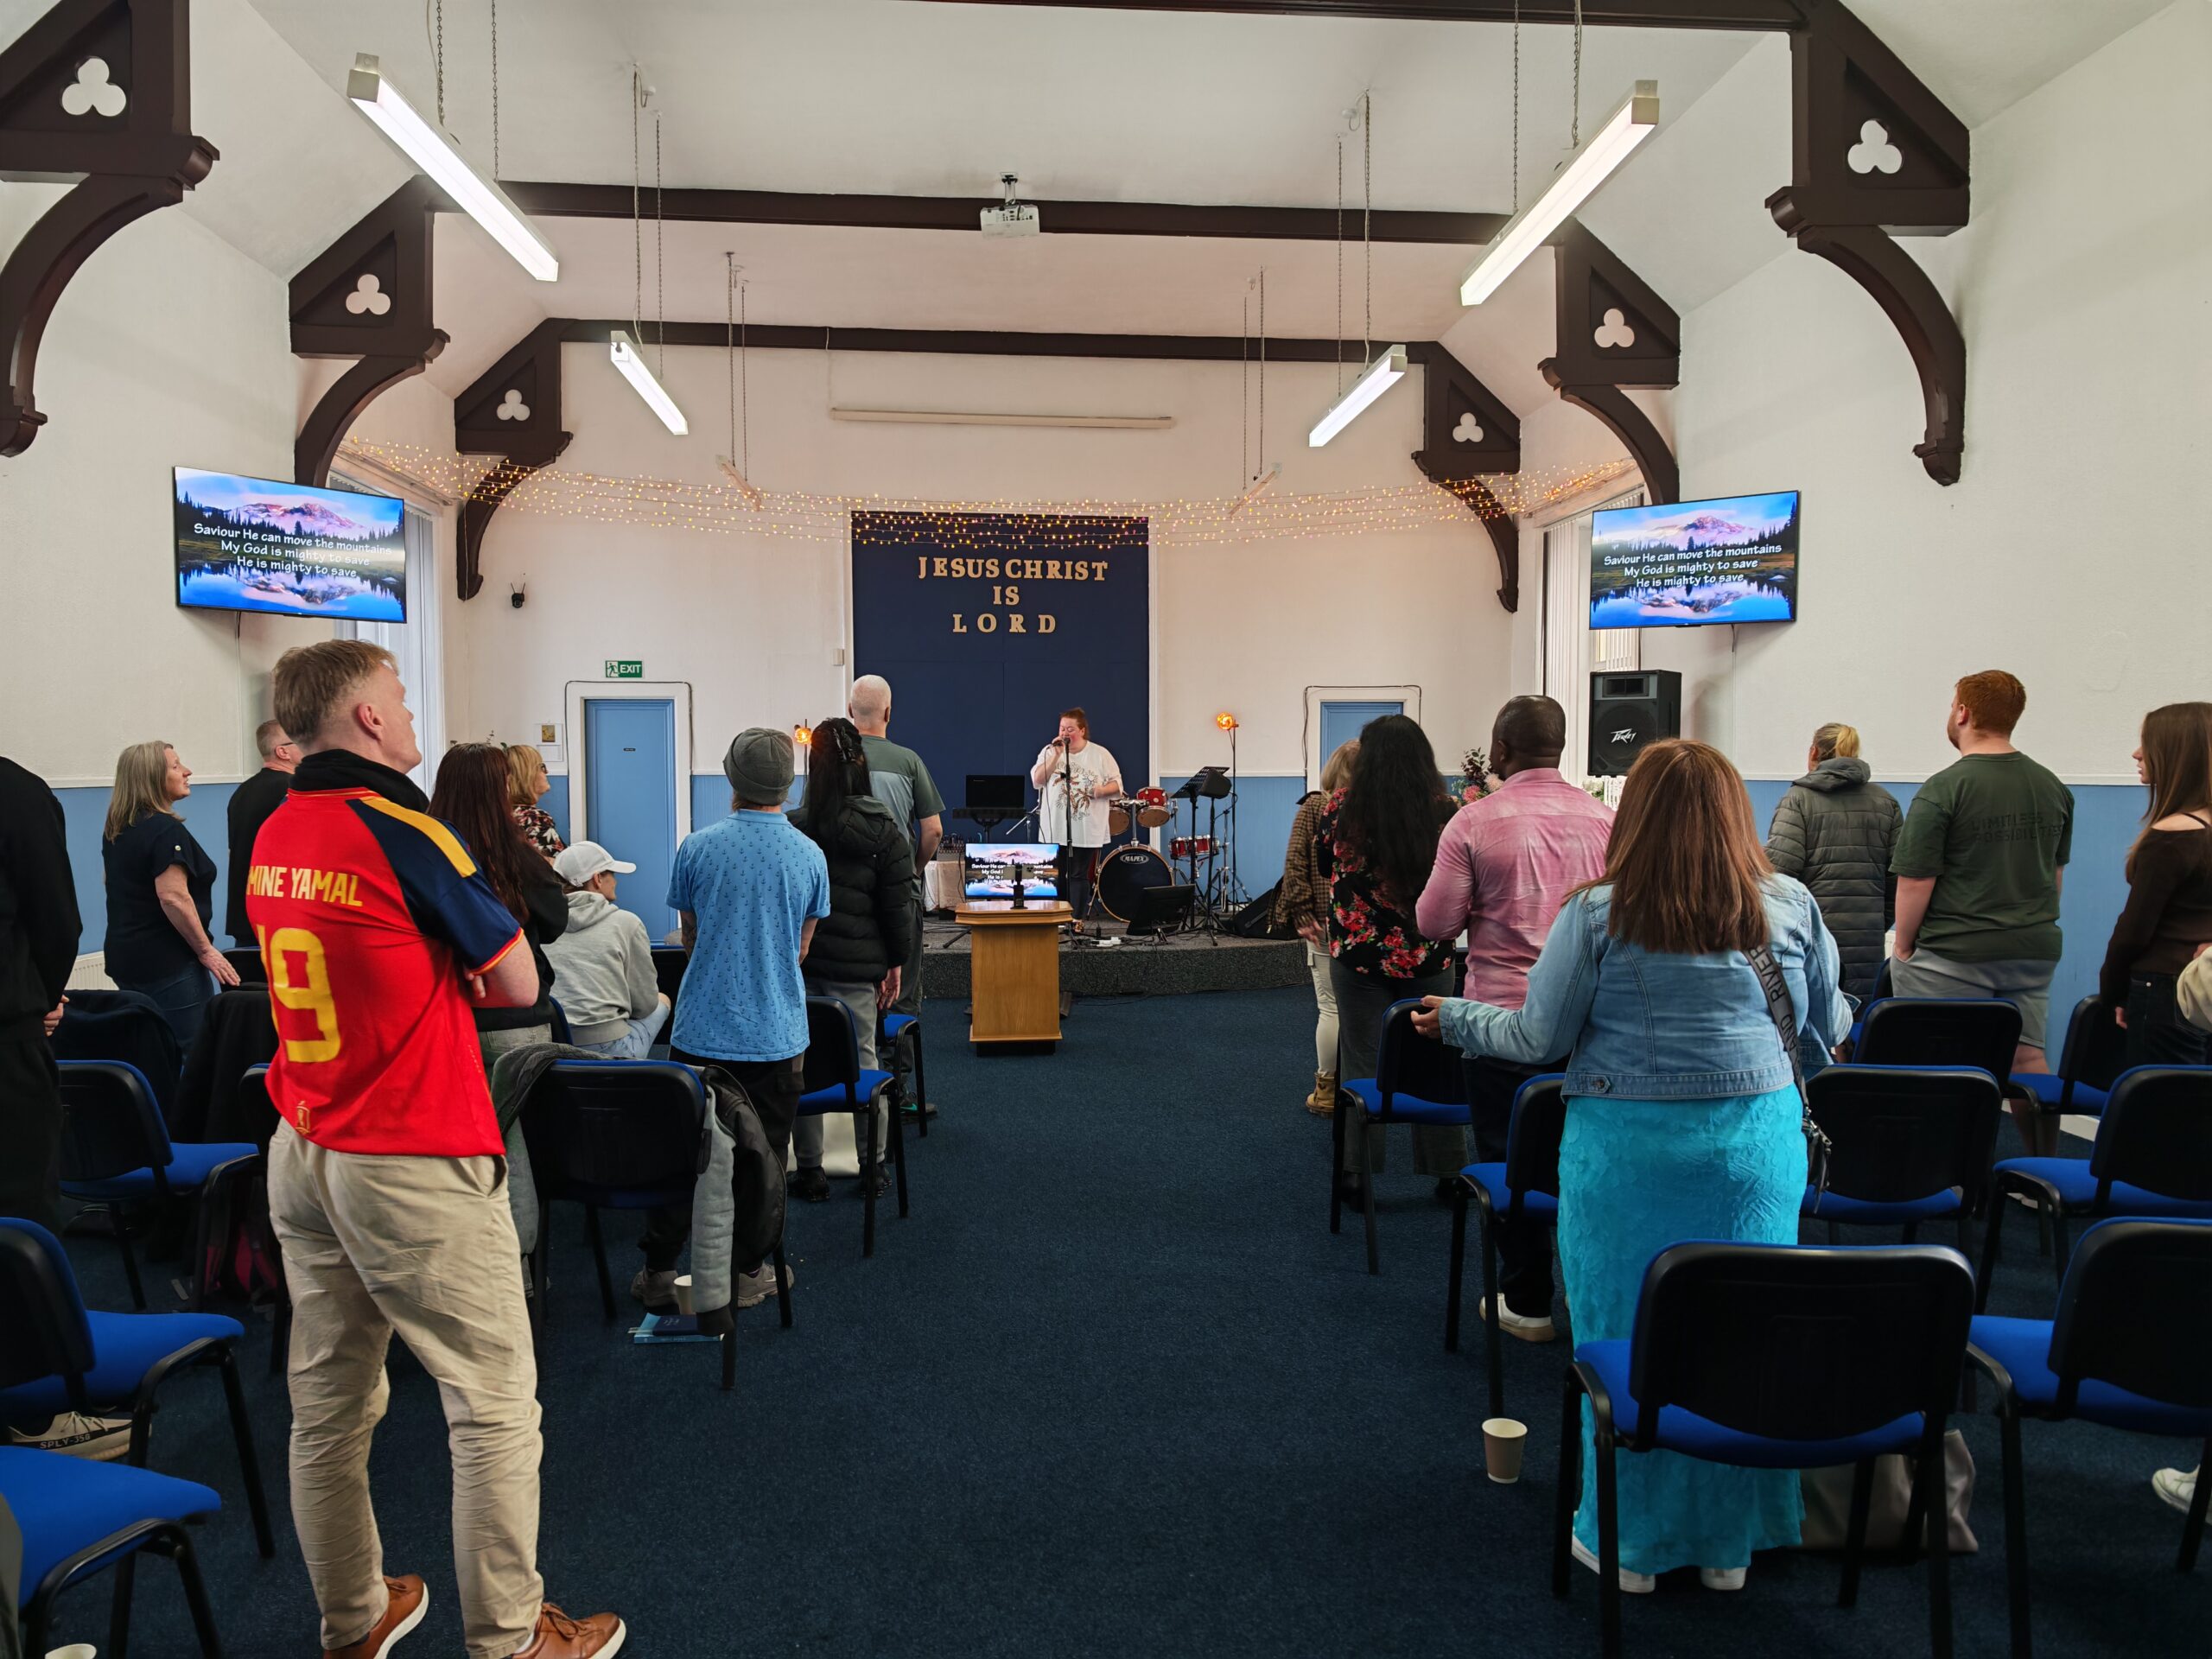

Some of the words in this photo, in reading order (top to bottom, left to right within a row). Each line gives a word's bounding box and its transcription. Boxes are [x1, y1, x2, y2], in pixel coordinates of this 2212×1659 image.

[194, 523, 241, 538] Saviour
[243, 528, 258, 540] He
[261, 533, 281, 543] can
[283, 536, 312, 546] move
[315, 537, 334, 549] the
[336, 542, 392, 555] mountains
[221, 539, 240, 554] My
[243, 542, 267, 555] God
[271, 545, 282, 556] is
[284, 548, 326, 563] mighty
[329, 554, 341, 563] to
[345, 556, 370, 566] save
[1604, 555, 1641, 565] Saviour
[1642, 552, 1656, 563] He
[1657, 553, 1675, 562] can
[1676, 550, 1703, 560] move
[1705, 548, 1723, 558] the
[1726, 543, 1782, 556] mountains
[237, 556, 253, 567] He
[257, 557, 267, 569] is
[270, 558, 312, 575] mighty
[315, 564, 327, 574] to
[331, 568, 357, 577] save
[918, 556, 1000, 579] JESUS
[1005, 558, 1109, 582] CHRIST
[1624, 566, 1640, 577] My
[1642, 564, 1662, 575] God
[1665, 563, 1675, 573] is
[1677, 562, 1715, 574] mighty
[1717, 561, 1730, 570] to
[1732, 560, 1758, 569] save
[1636, 578, 1650, 588] He
[1652, 577, 1662, 587] is
[1664, 575, 1701, 588] mighty
[1703, 575, 1716, 583] to
[1719, 574, 1745, 582] save
[993, 585, 1020, 606] IS
[952, 613, 1057, 633] LORD
[620, 664, 641, 674] EXIT
[291, 868, 363, 906] YAMAL
[1748, 947, 1786, 1003] RIVER
